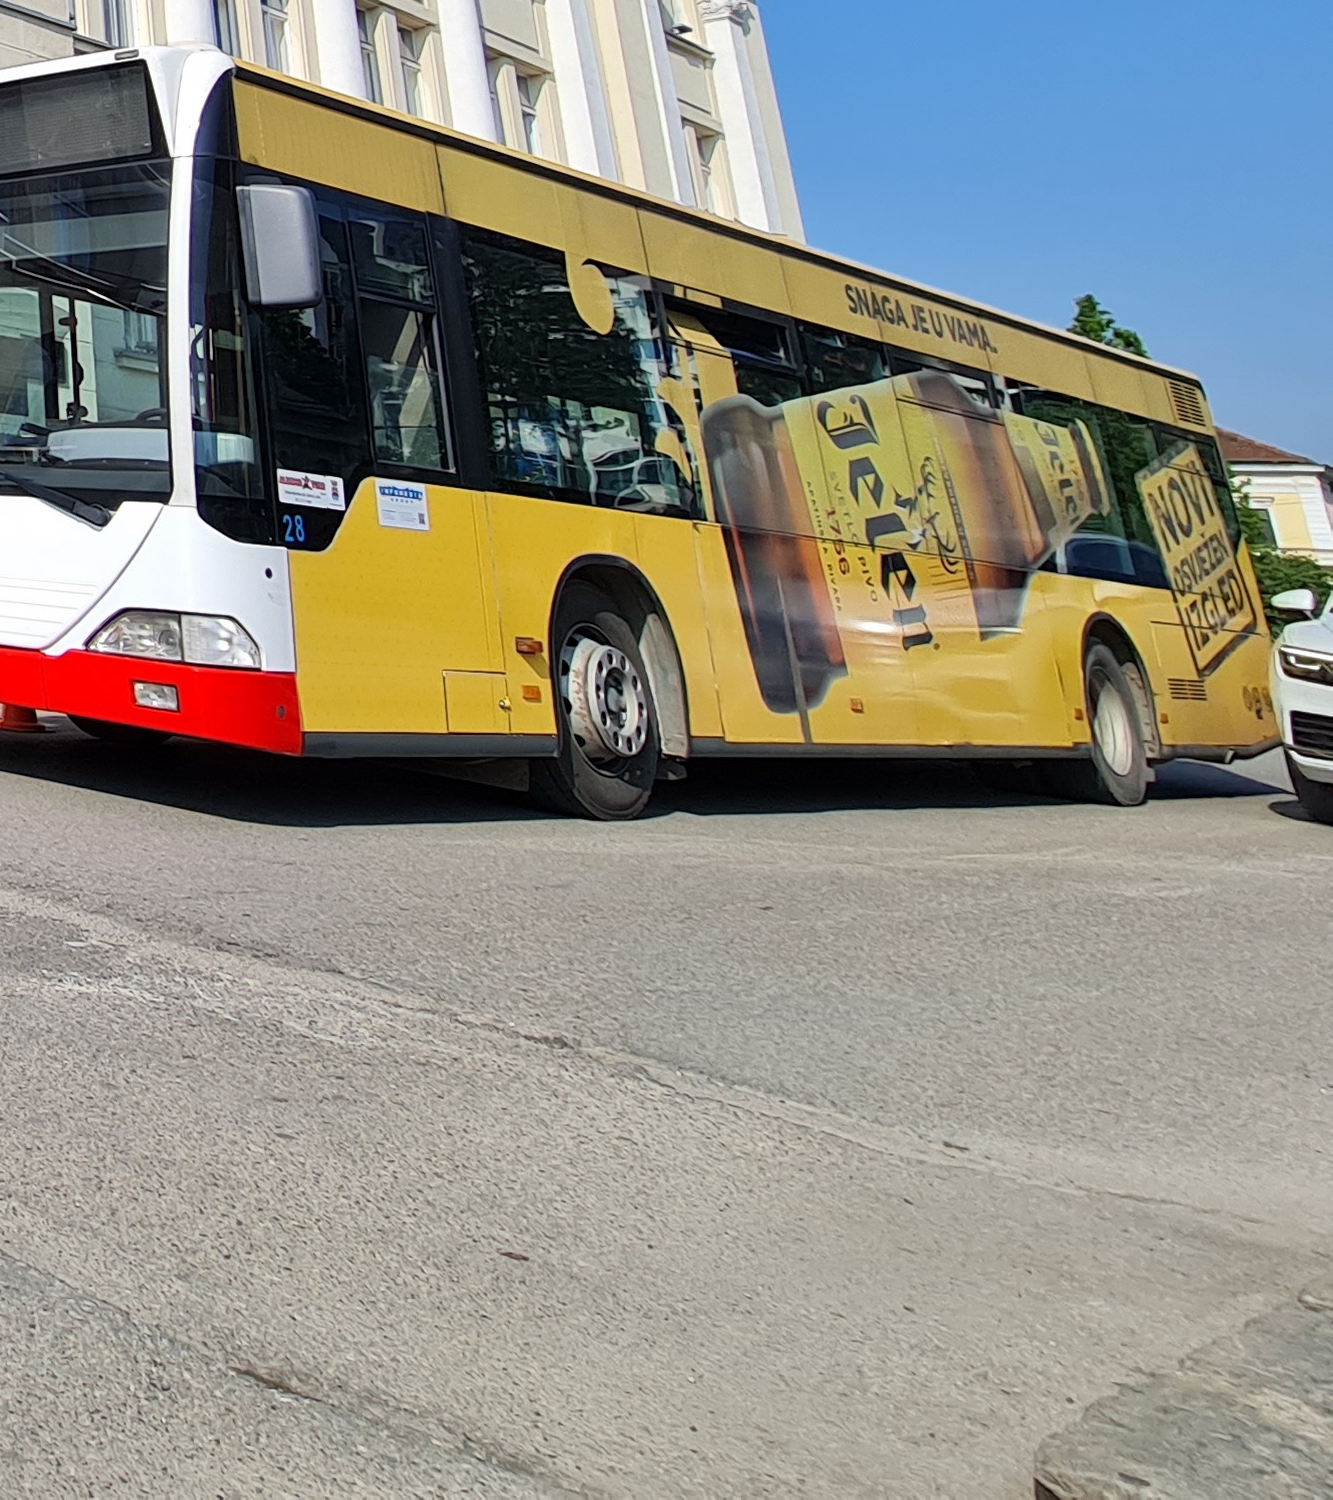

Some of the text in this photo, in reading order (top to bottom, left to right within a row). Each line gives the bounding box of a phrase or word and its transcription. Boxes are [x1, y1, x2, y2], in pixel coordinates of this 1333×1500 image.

[845, 284, 998, 355] SNAGA JE U VAMA.
[283, 515, 305, 542] 28
[817, 394, 933, 651] Jelen
[1148, 459, 1215, 553] NOVI
[825, 507, 850, 576] 1756
[1172, 530, 1232, 598] OSVJEŽEN
[858, 556, 879, 603] PIVO
[1184, 568, 1245, 651] IZGLED
